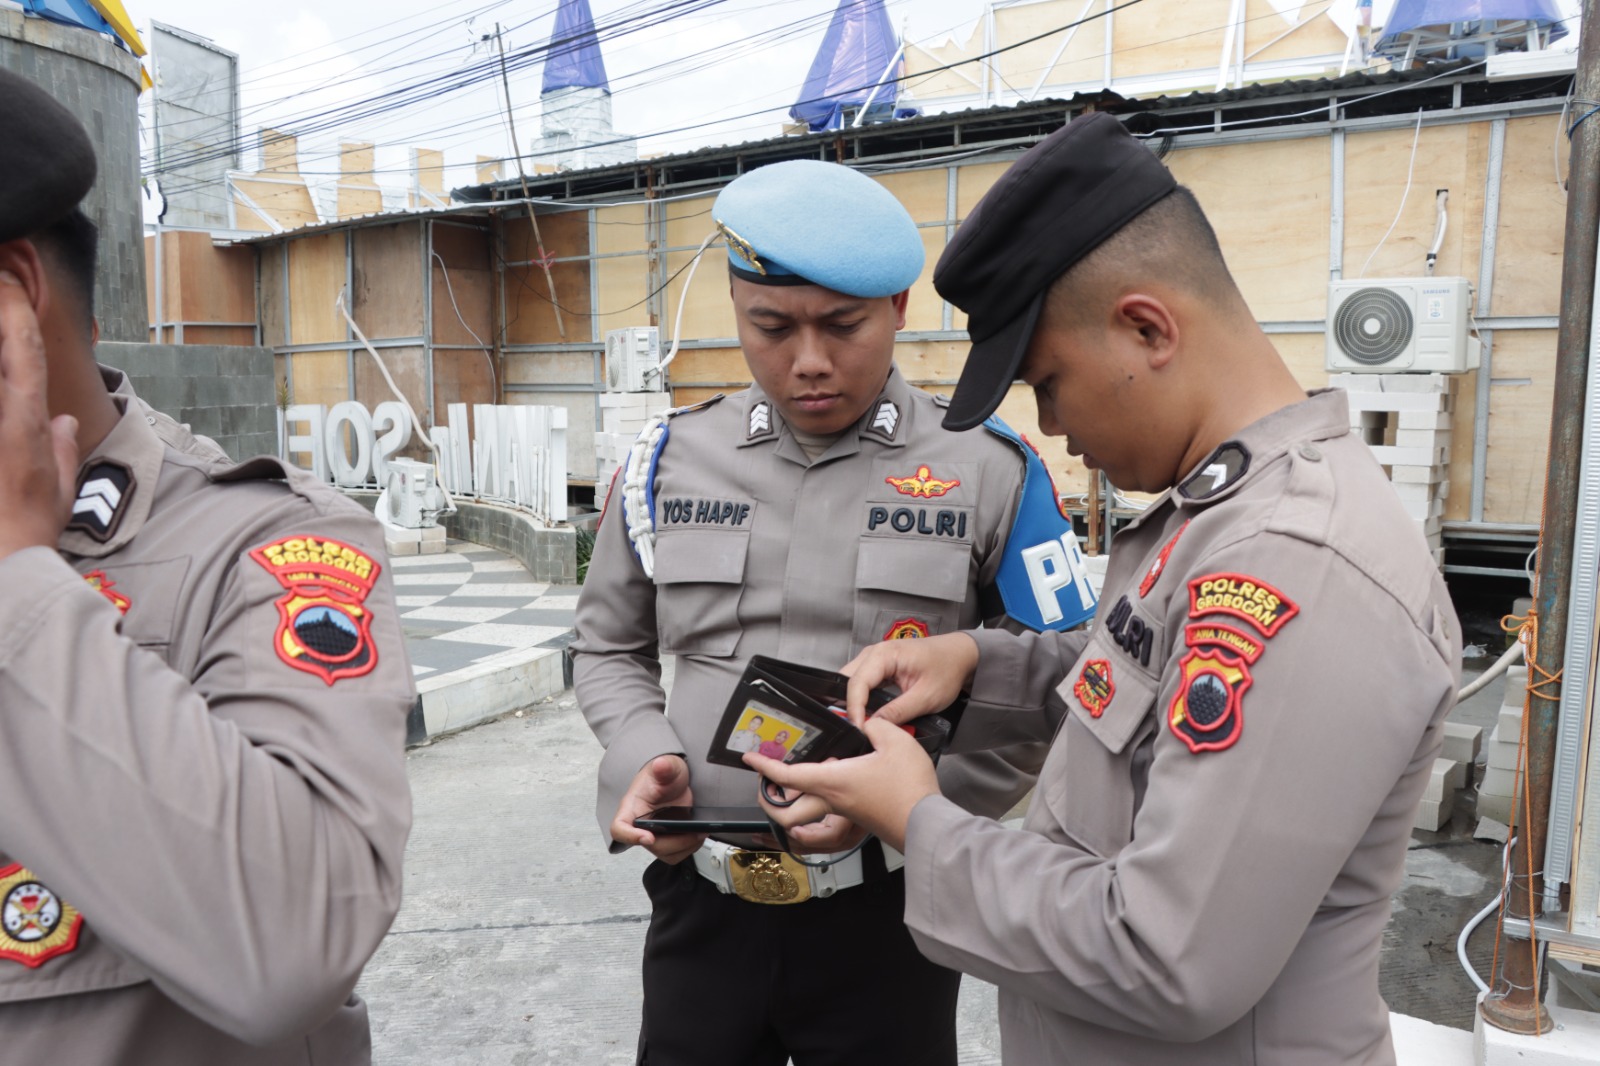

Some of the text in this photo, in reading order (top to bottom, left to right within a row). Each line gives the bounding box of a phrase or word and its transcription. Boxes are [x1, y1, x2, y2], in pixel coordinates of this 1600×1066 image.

[662, 498, 751, 527] YOS HAPIF
[868, 506, 967, 538] POLRI
[1196, 592, 1278, 627] GROBOGAN
[1200, 578, 1281, 612] POLRES
[1216, 630, 1257, 656] TENGAH
